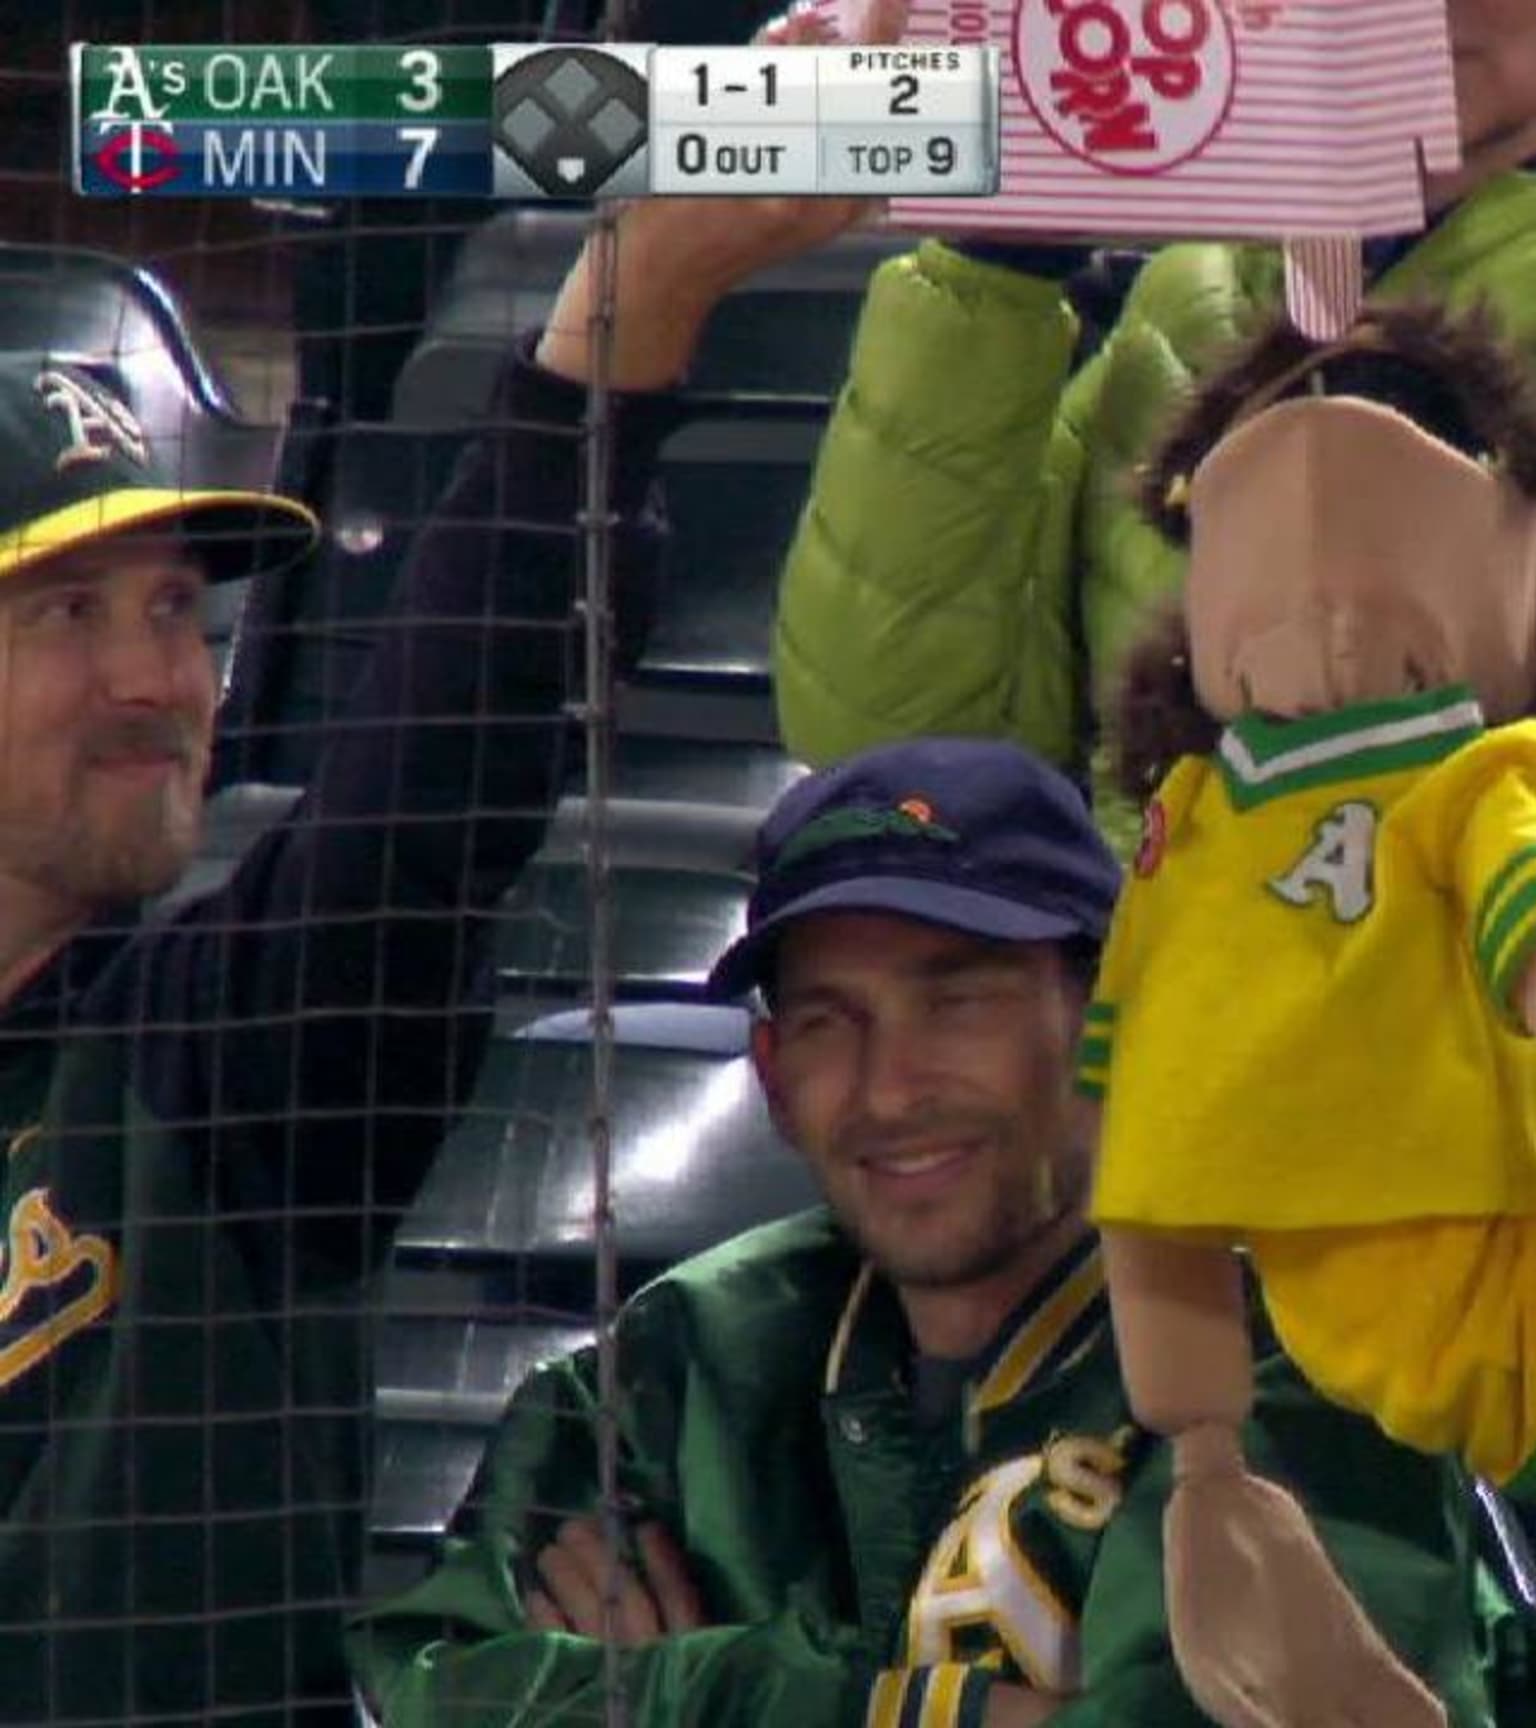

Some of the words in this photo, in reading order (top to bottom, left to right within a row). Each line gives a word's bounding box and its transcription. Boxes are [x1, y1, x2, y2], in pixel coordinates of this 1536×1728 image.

[1047, 0, 1156, 150] ORN
[1131, 0, 1209, 99] OP
[1268, 803, 1378, 923] A
